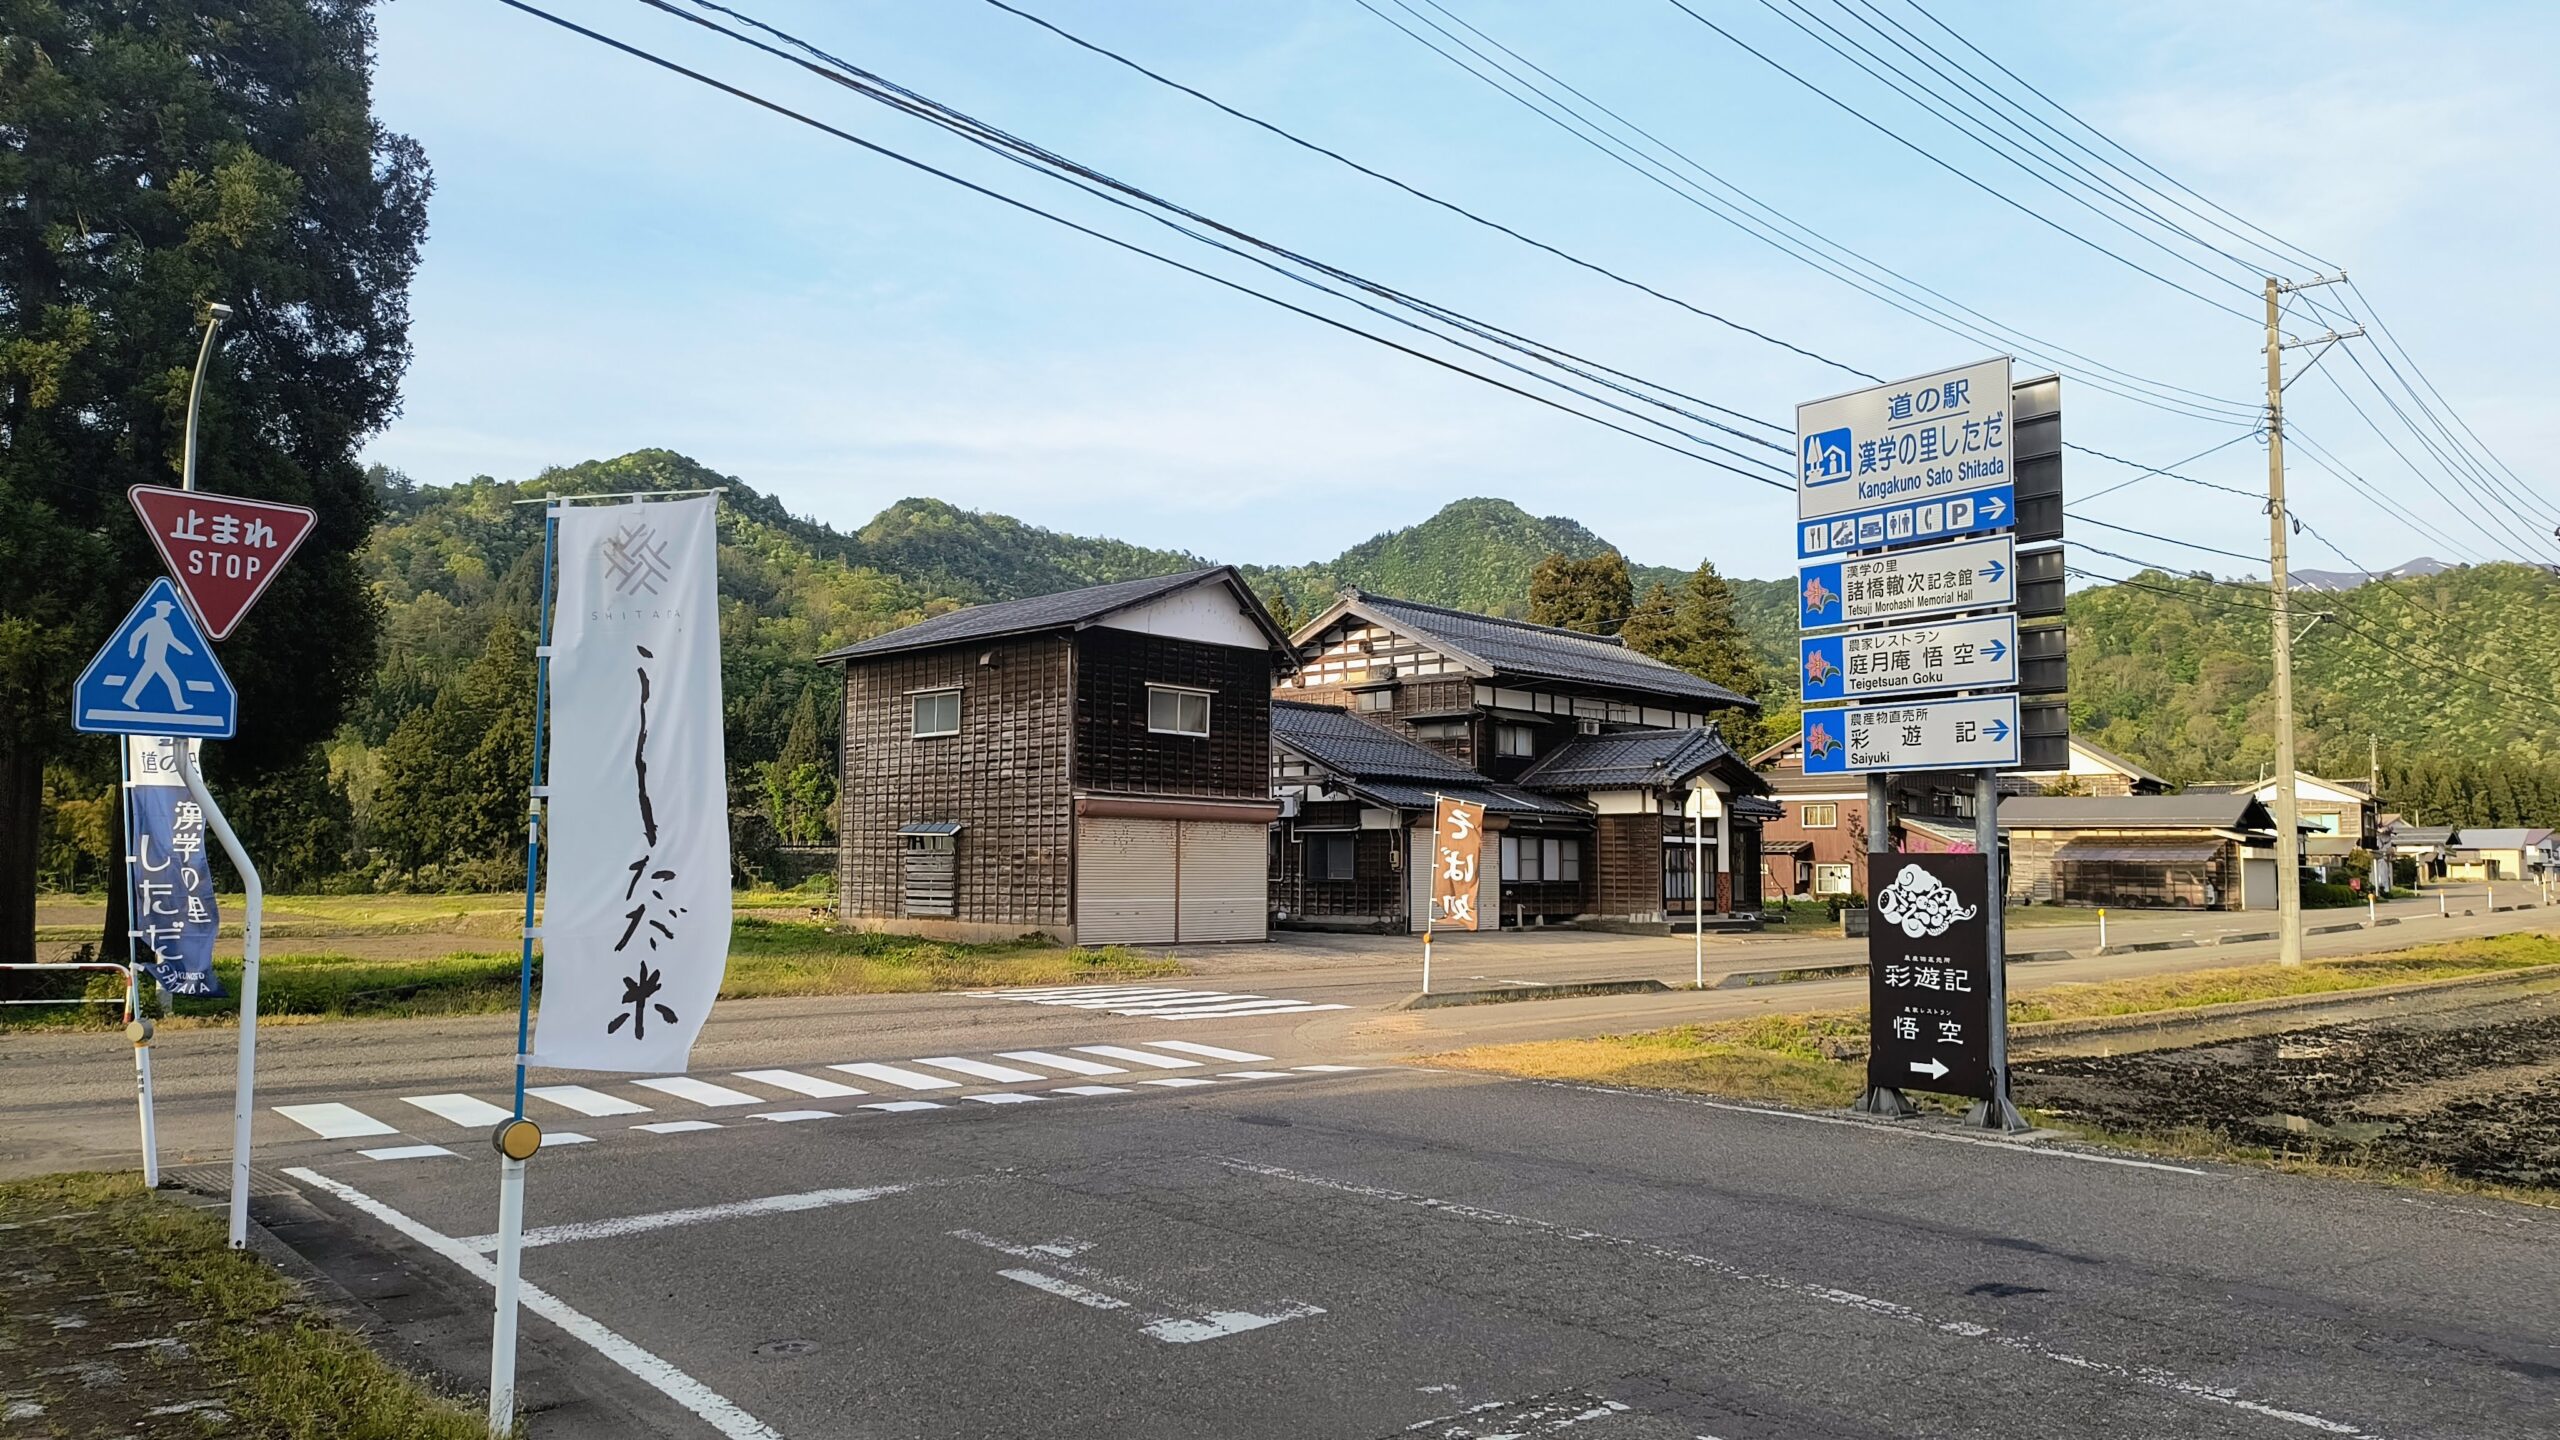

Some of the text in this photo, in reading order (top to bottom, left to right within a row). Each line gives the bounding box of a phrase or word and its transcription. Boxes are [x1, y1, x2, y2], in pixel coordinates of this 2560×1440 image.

[1887, 378, 1970, 422] 道の駅
[1858, 410, 2003, 477] 漢学の里しただ
[1858, 456, 2004, 500] Kangakuno Sato Shitada
[169, 508, 278, 549] 止まれ
[188, 550, 261, 580] STOP
[1847, 559, 1898, 579] 漢学の里
[1847, 568, 1973, 602] 諸橋轍次記念館
[1848, 589, 1973, 616] Tetsuji Morohashi Memorial Hall
[1849, 631, 1940, 652] 農家レストラン
[1849, 650, 1911, 675] 庭月庵
[1849, 672, 1943, 690] Teigetsuan Goku
[1850, 708, 1928, 726] 農産物直売所
[1850, 752, 1890, 765] Saiyuki
[172, 801, 211, 923] 漢学の里
[139, 834, 184, 962] しただ
[1885, 964, 1972, 993] 彩遊記
